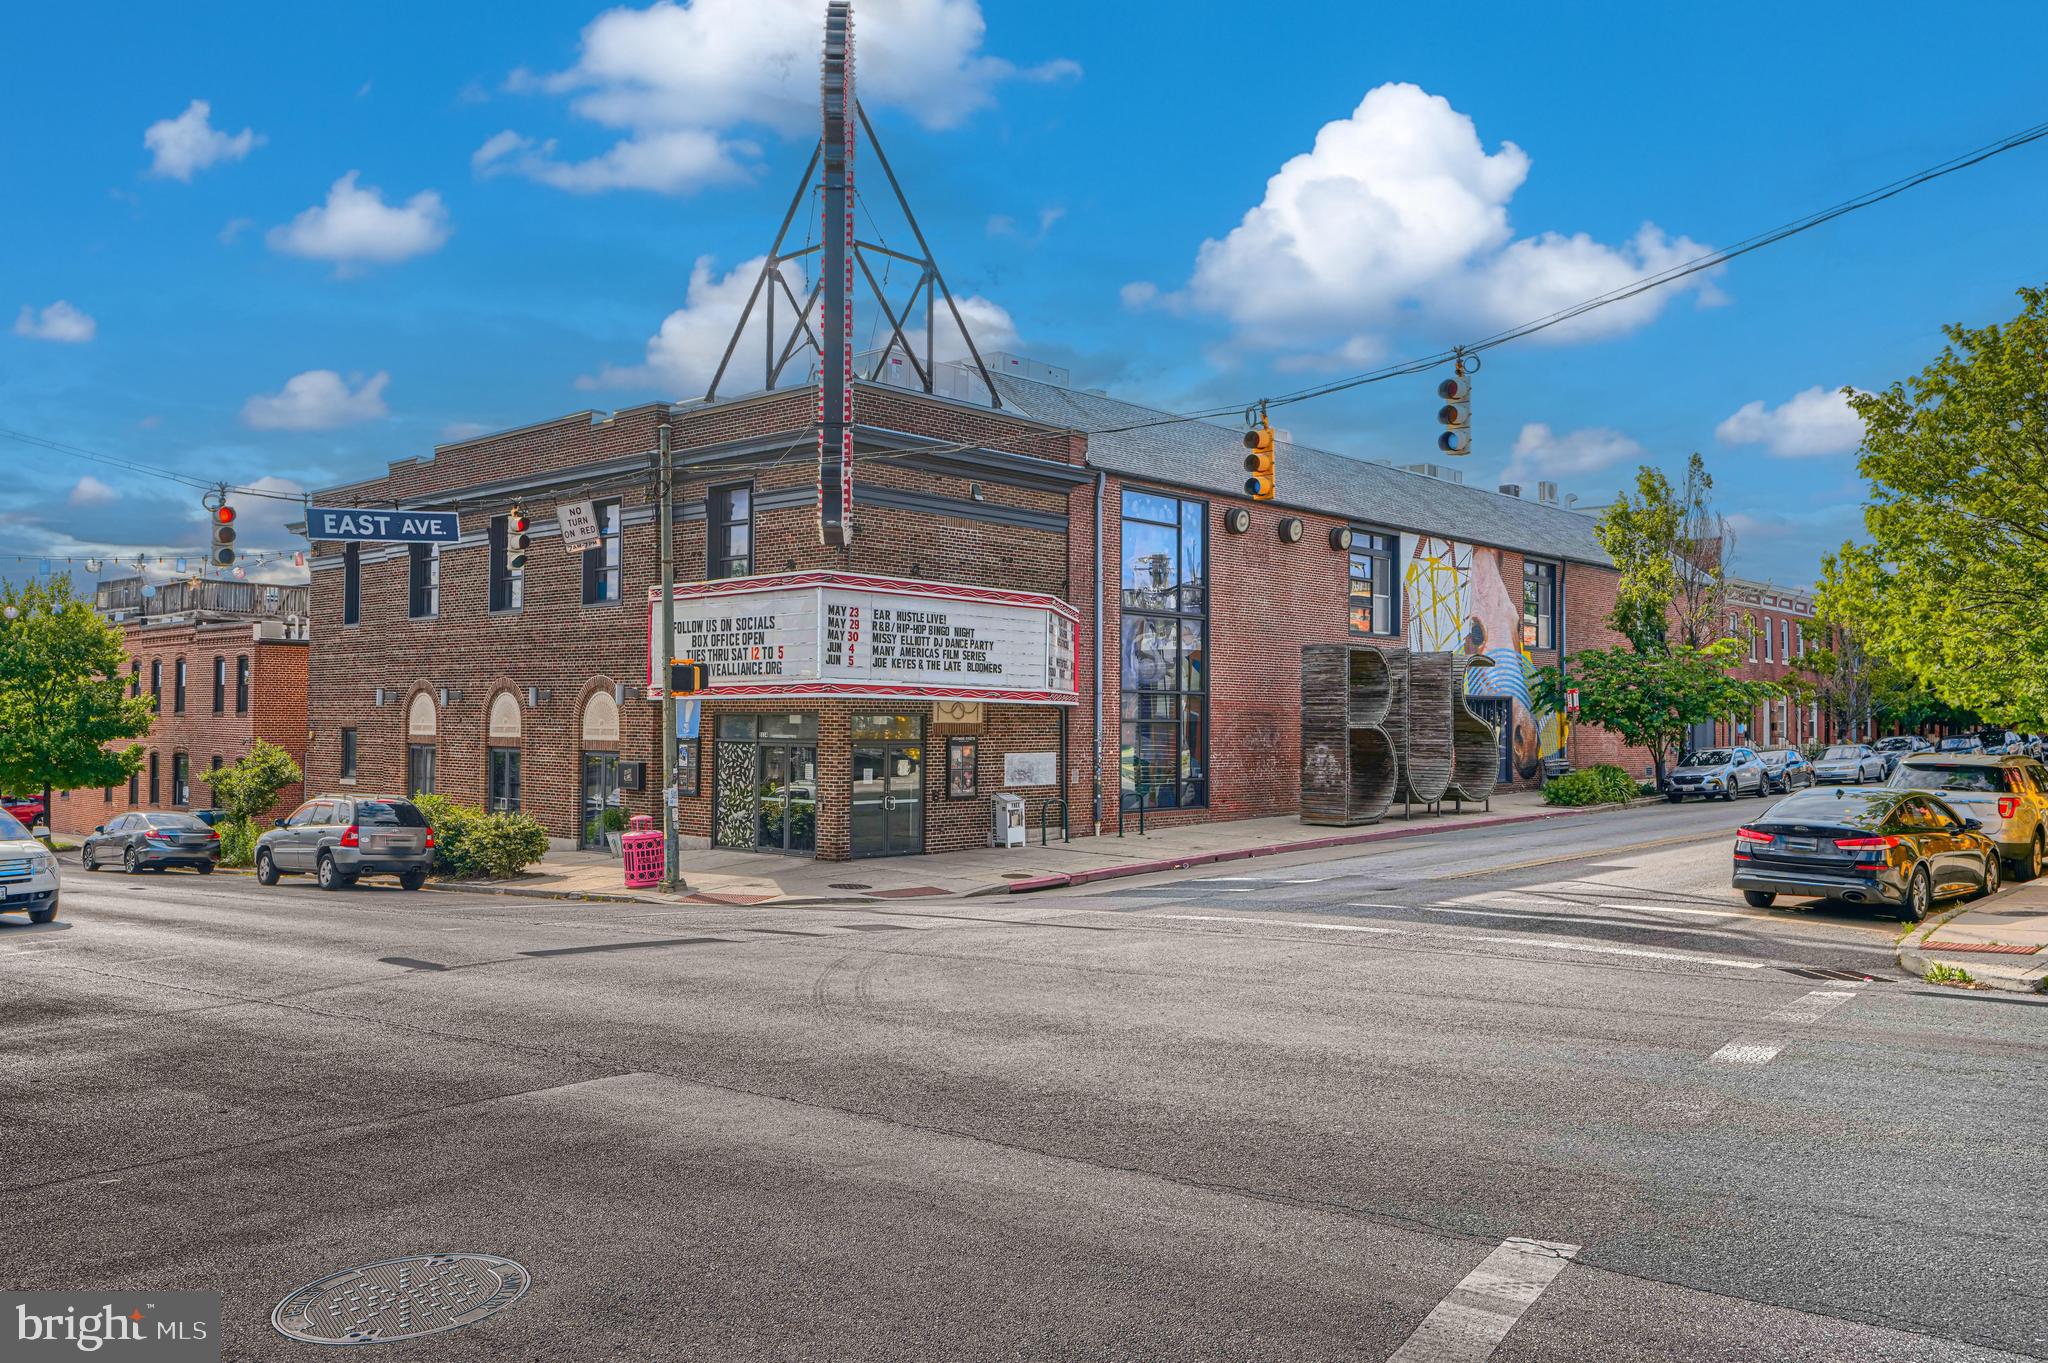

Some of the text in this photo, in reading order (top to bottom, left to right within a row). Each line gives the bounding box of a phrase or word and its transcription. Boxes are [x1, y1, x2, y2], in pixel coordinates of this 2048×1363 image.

[570, 507, 582, 516] NO
[324, 514, 447, 536] EAST AVE.
[567, 516, 588, 527] TURN
[564, 526, 595, 538] ON RED
[828, 604, 946, 624] MAY 23 EAR HUSTLE LIVE!
[706, 620, 717, 632] US
[720, 618, 732, 631] ON
[736, 616, 775, 630] SOCIALS
[828, 617, 846, 629] MAY
[850, 620, 860, 630] 29
[928, 626, 949, 636] BINGO
[954, 627, 975, 638] NIGHT
[692, 632, 764, 648] BOX OFFICE OPEN
[828, 629, 994, 651] MAY 30 MISSY ELLIOTT DJ DANCE PARTY
[686, 646, 784, 662] TUES THRU SAT 12 TO 5
[827, 642, 986, 662] JUN 4 MANY AMERICAS FILM SERIES
[708, 661, 782, 676] IVEALLIANCE.ORG
[826, 654, 1002, 674] JUN 5 JOE KEYES & THE LATE BLOOMERS
[1300, 644, 1498, 826] BUS
